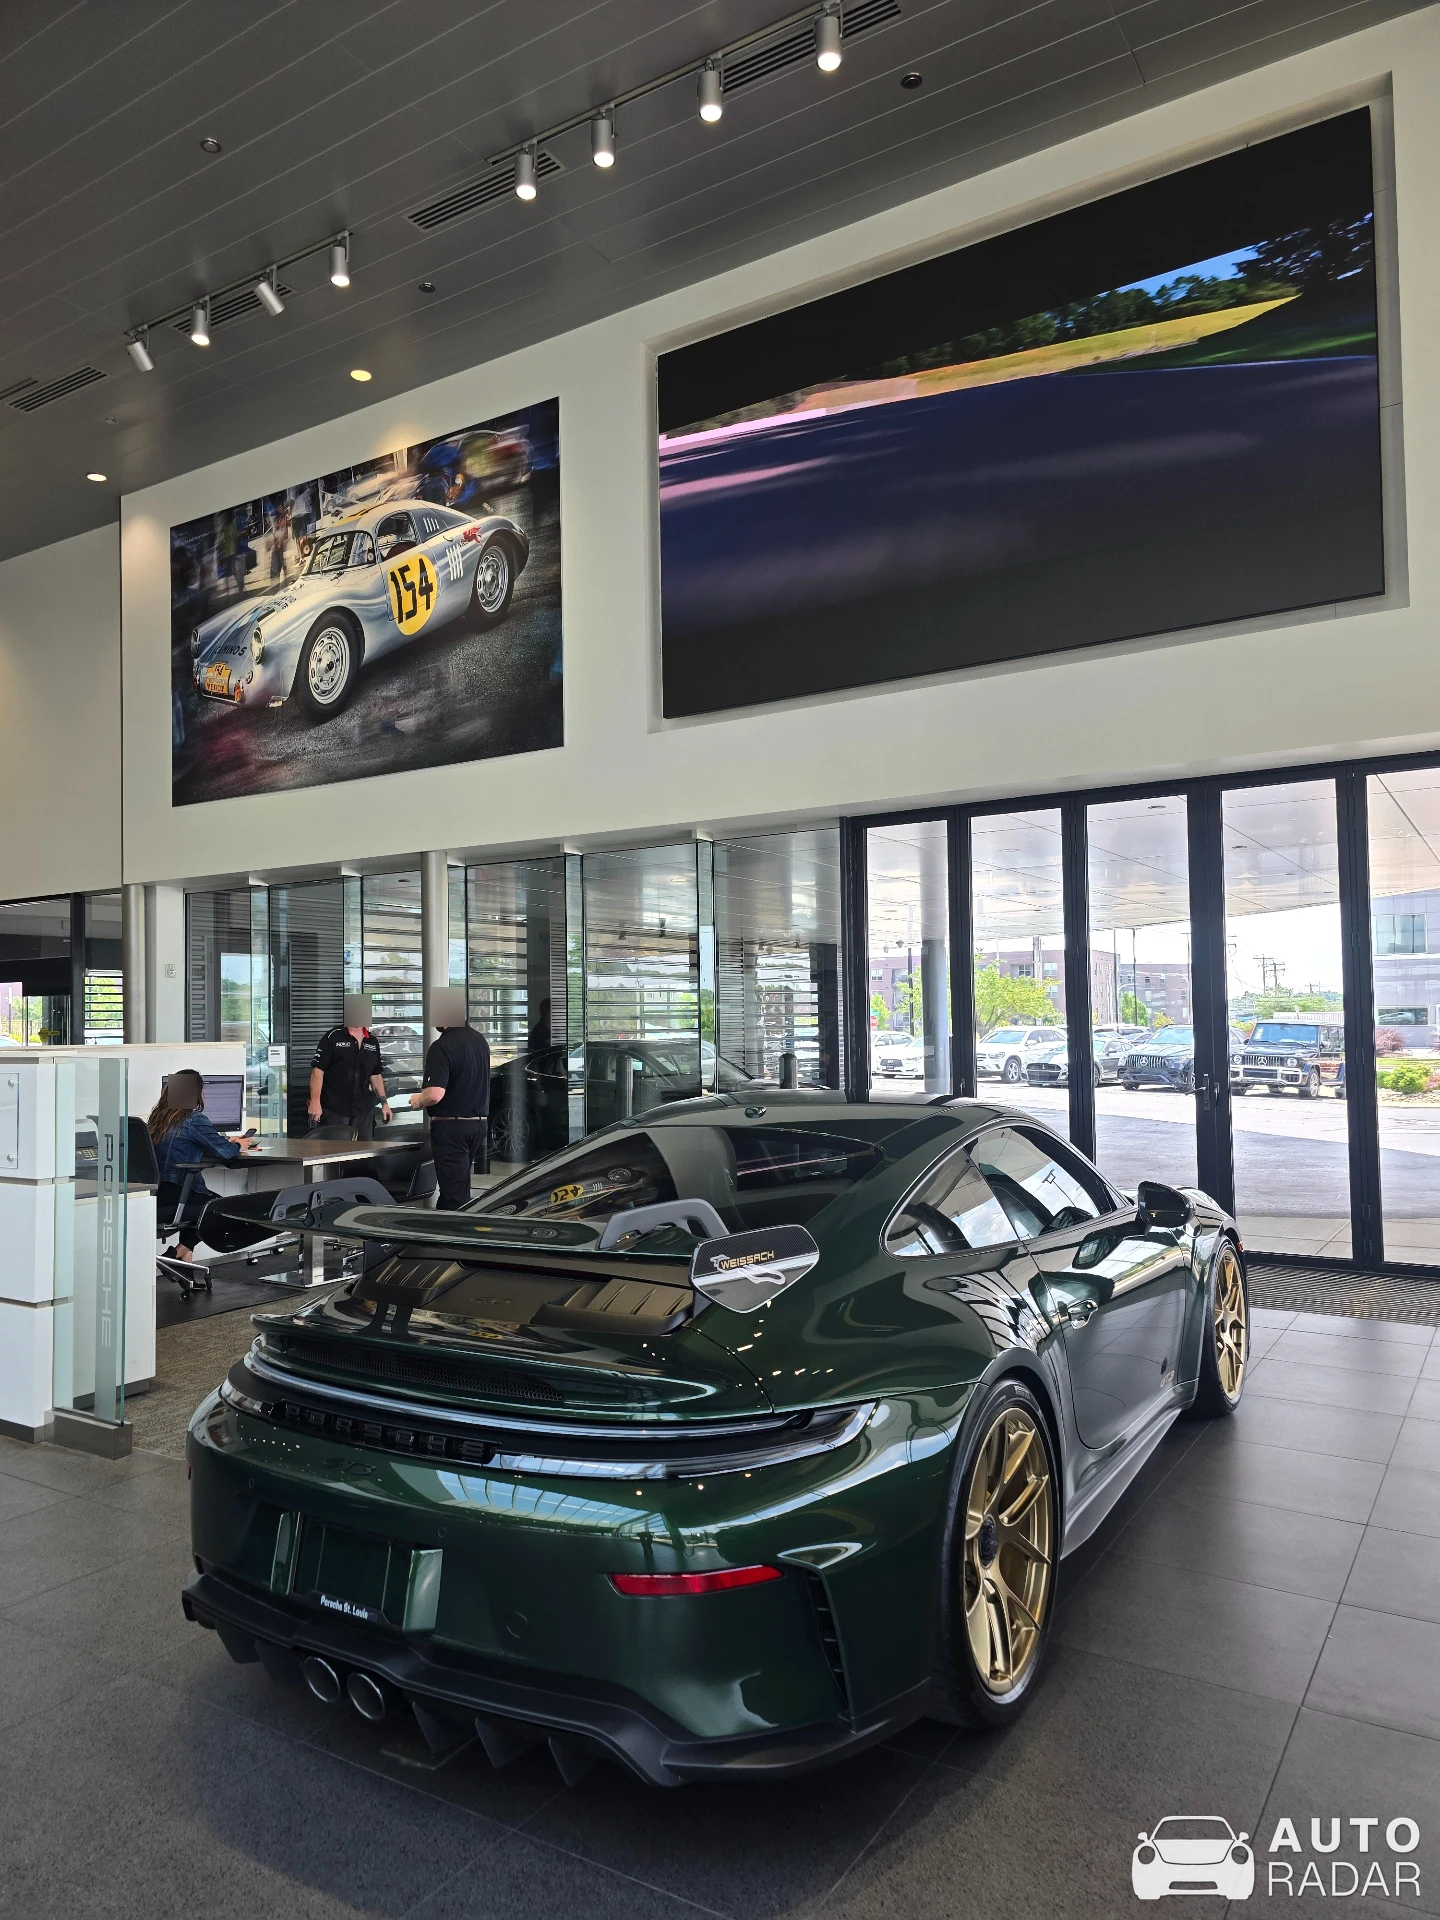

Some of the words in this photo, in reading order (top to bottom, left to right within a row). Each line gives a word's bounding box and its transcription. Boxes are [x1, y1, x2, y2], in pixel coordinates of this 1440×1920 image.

[390, 558, 433, 624] 154
[101, 1133, 114, 1348] PORSCHE
[720, 1250, 775, 1270] WEISSACH
[1159, 1370, 1175, 1389] GT3
[285, 1403, 485, 1463] PORSCHE
[323, 1456, 378, 1476] GT3
[321, 1595, 343, 1611] Porsche
[343, 1602, 351, 1614] St.
[352, 1605, 368, 1619] Louis
